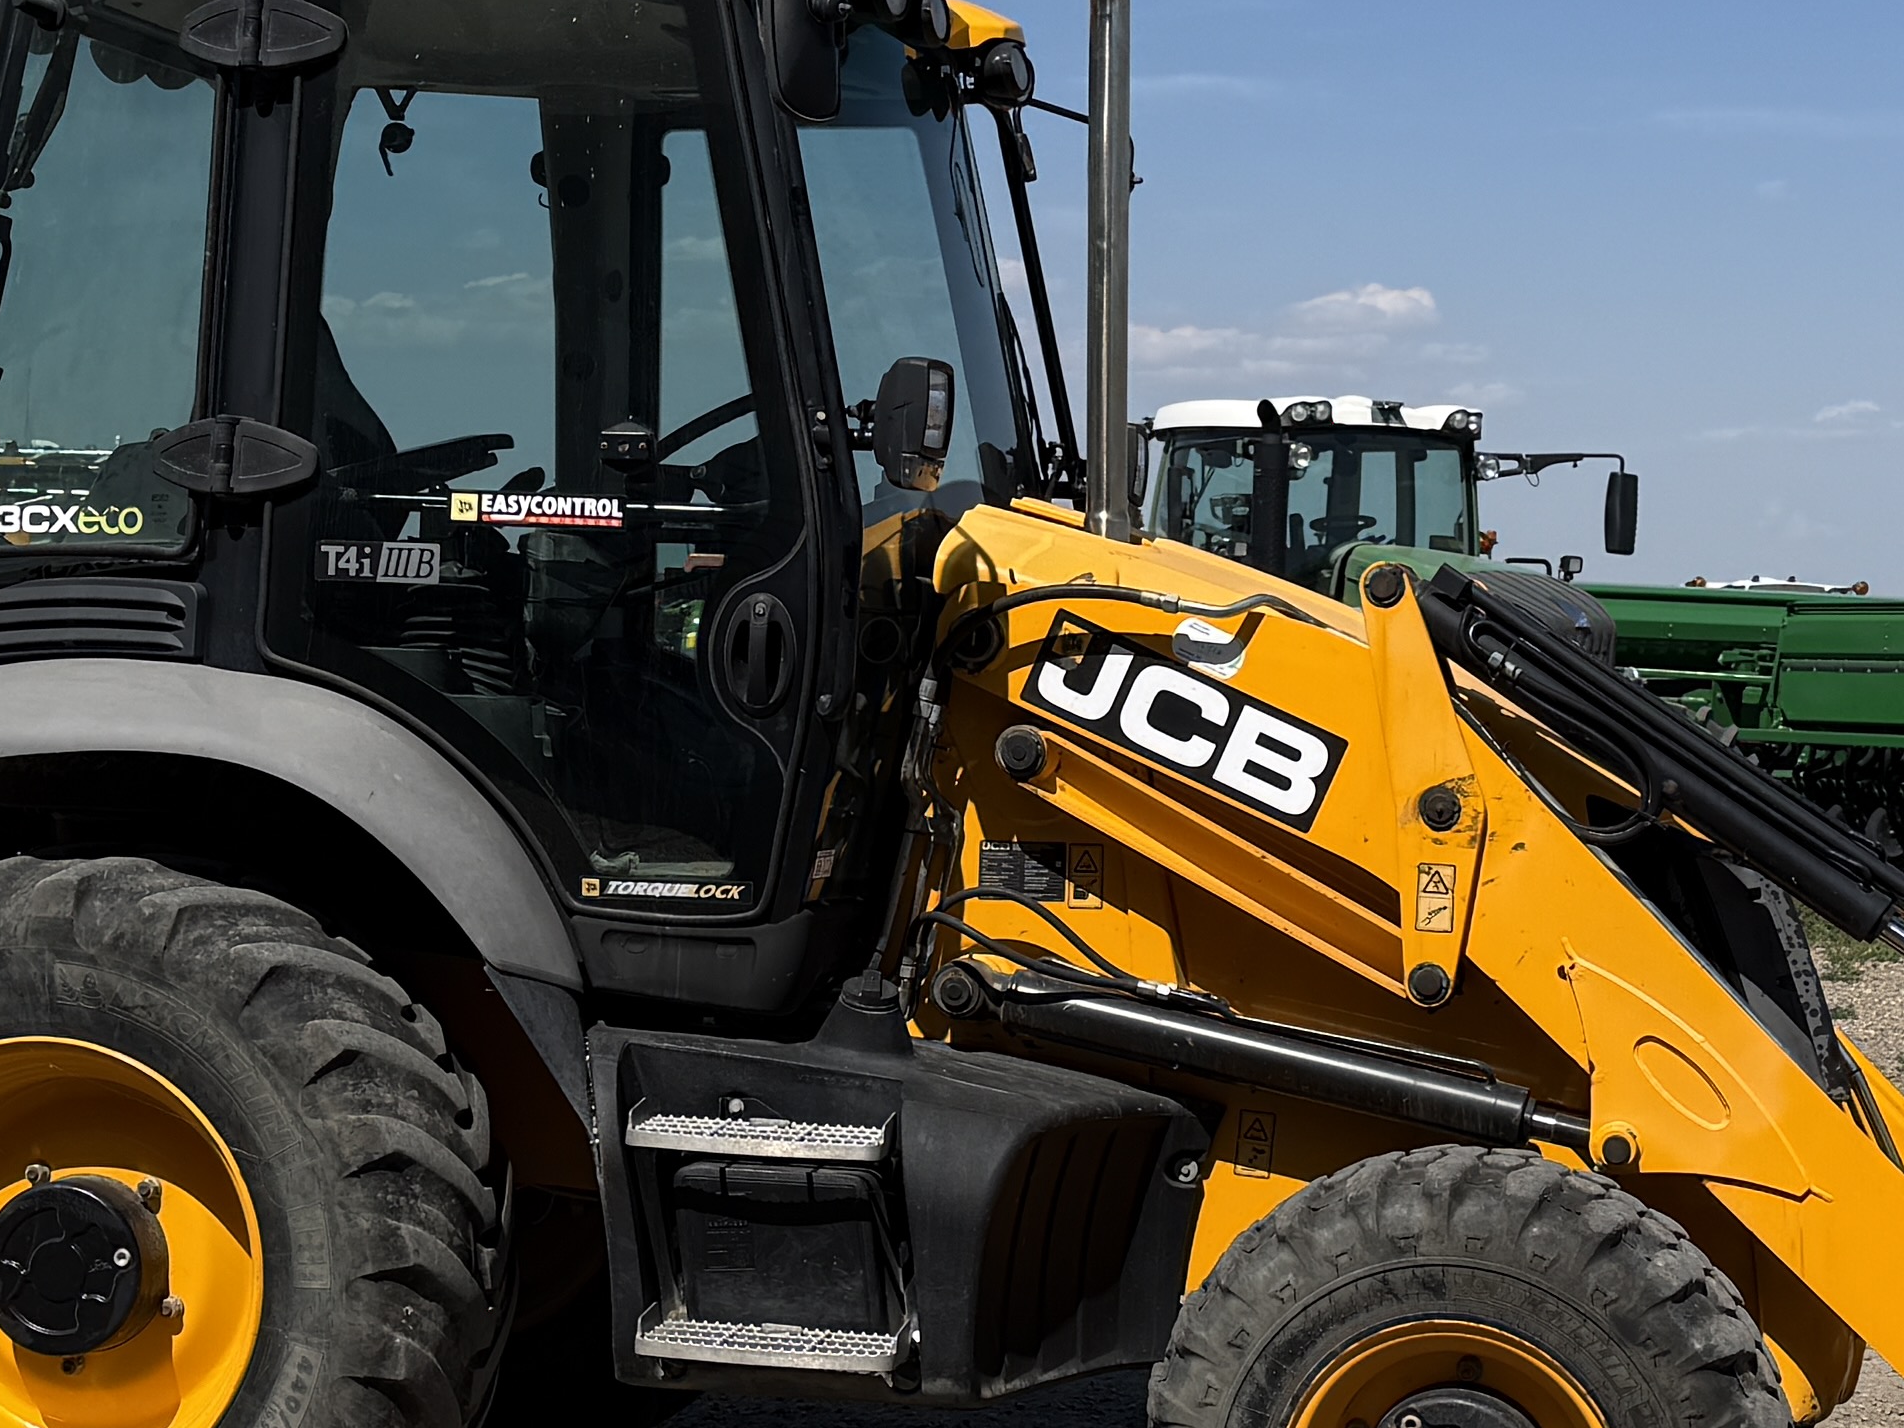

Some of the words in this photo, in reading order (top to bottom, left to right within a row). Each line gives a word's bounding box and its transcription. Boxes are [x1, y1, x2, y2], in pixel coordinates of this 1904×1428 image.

[320, 544, 374, 578] T4i
[1036, 643, 1332, 817] JCB
[605, 880, 746, 900] TORQUELOCK
